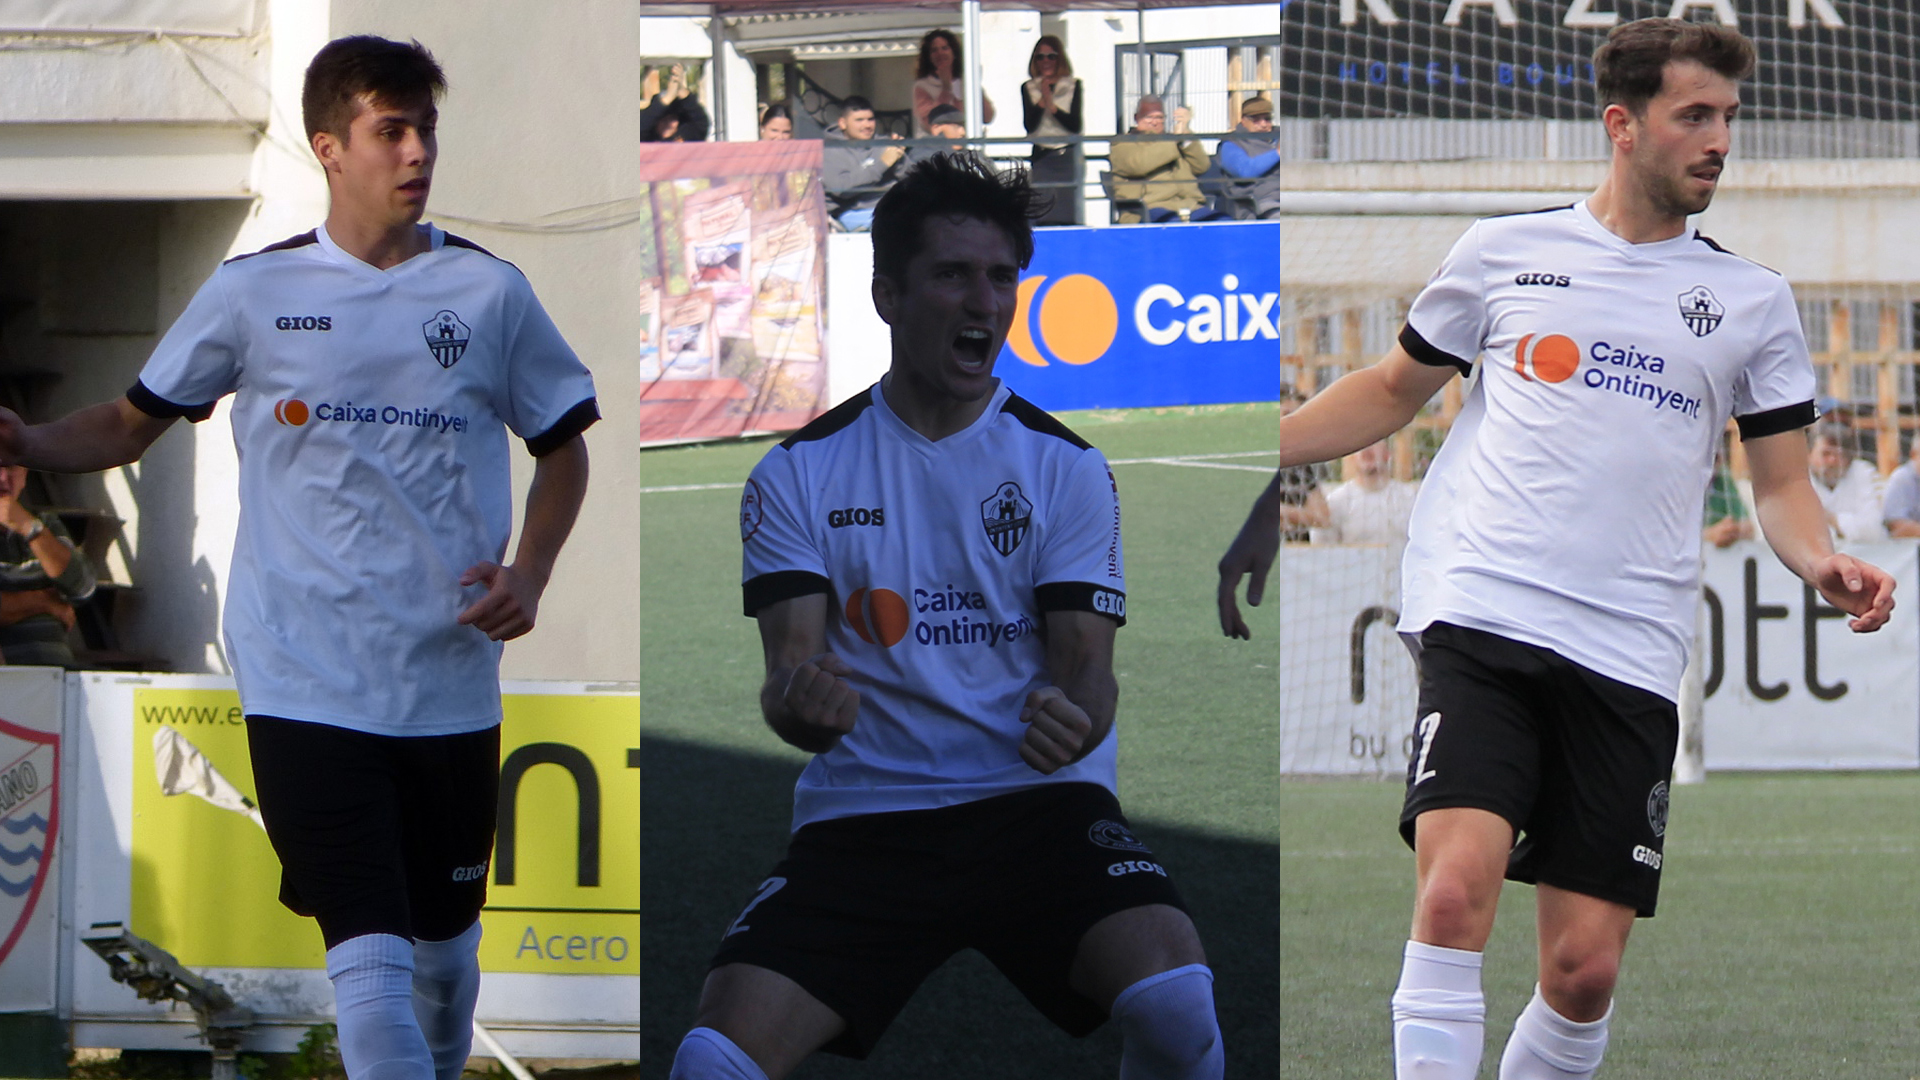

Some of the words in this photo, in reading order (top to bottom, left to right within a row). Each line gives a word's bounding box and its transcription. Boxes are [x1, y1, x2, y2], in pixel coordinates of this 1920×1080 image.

[1338, 61, 1467, 85] HOTEL
[1515, 273, 1571, 287] GIOS
[1134, 273, 1280, 346] Caix
[275, 316, 332, 331] GIOS
[1590, 341, 1665, 374] Caixa
[1584, 368, 1701, 419] Ontinyent
[315, 402, 376, 423] Caixa
[828, 507, 886, 529] GIOS
[914, 584, 987, 613] Caixa
[1092, 590, 1126, 617] GIO
[1414, 711, 1442, 786] 2
[1107, 861, 1167, 877] GIOS
[1632, 844, 1662, 870] GIOS
[452, 861, 488, 881] GIOS
[516, 926, 629, 962] Acero
